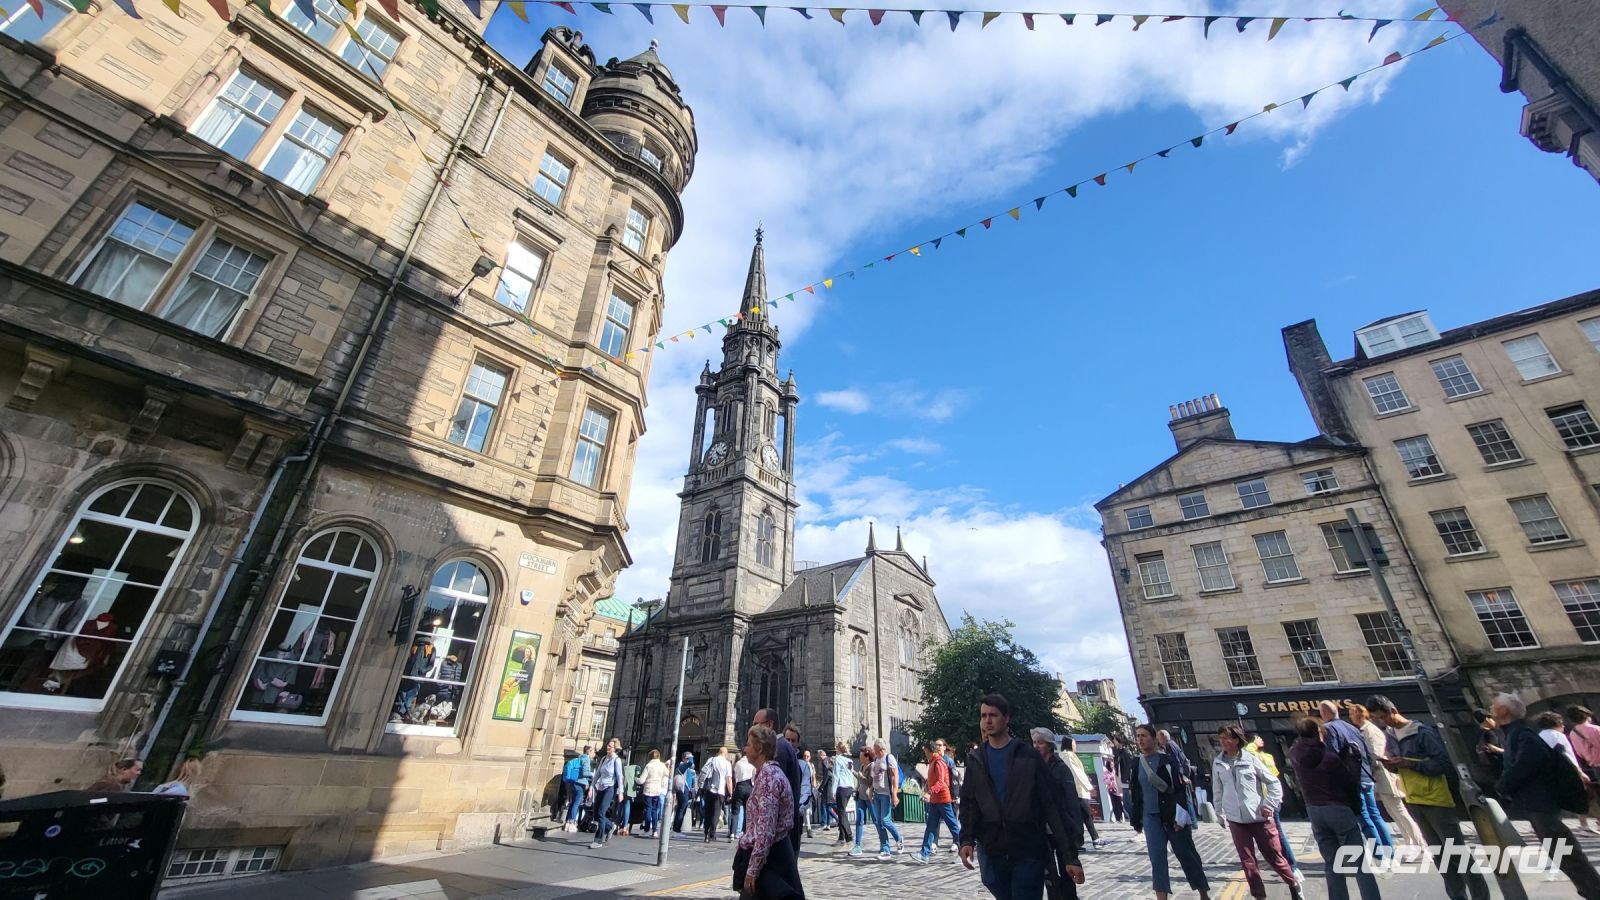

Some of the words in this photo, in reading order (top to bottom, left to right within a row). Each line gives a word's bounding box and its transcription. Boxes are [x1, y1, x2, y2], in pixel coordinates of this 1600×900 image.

[522, 553, 556, 567] COCKBURN
[526, 561, 549, 572] STREET
[1258, 699, 1353, 713] STARBUKS
